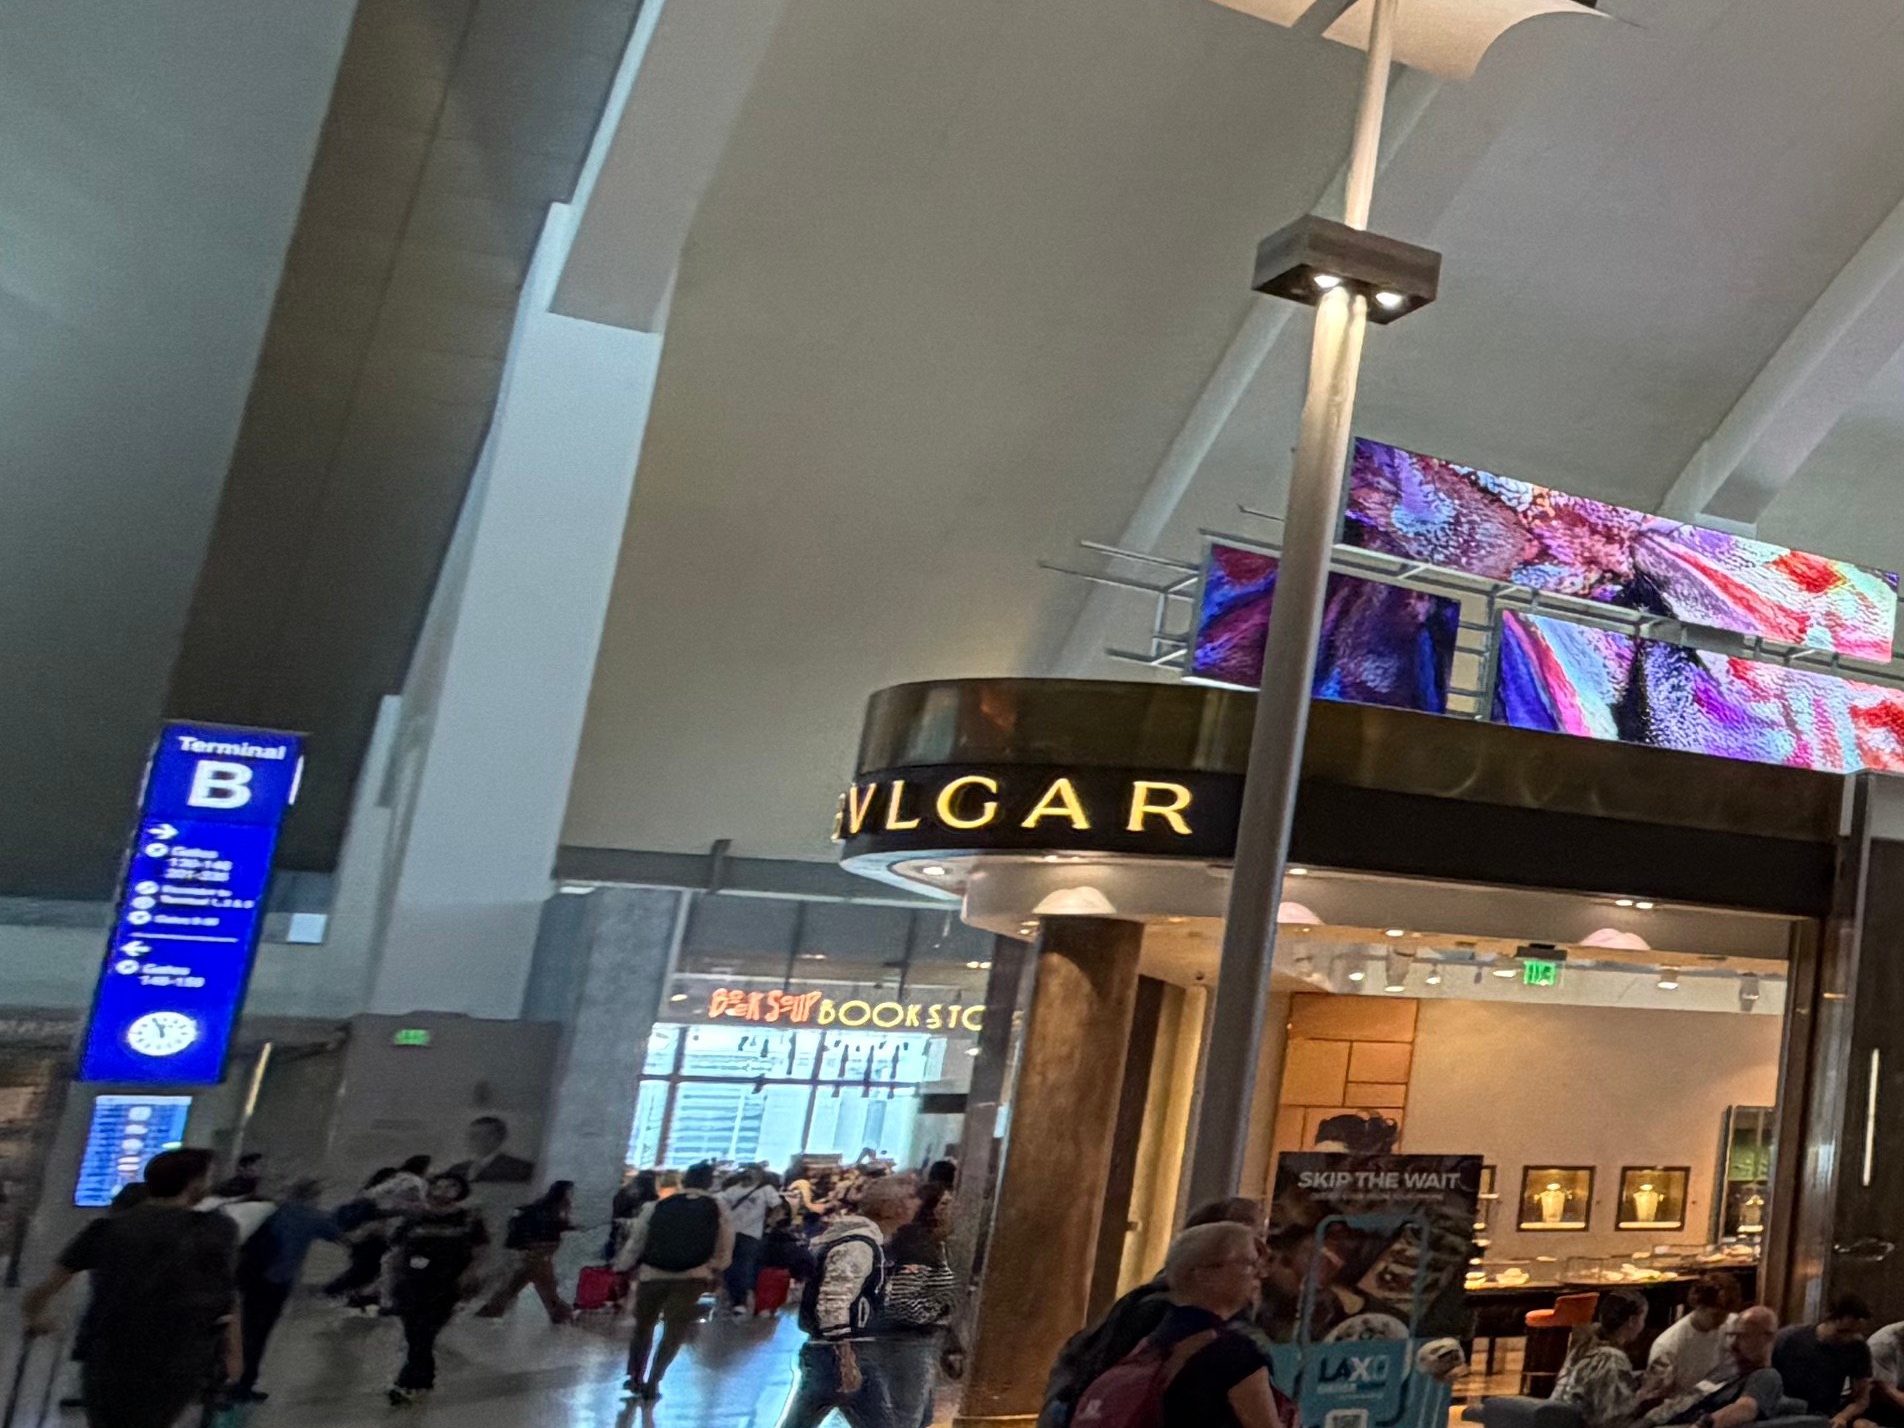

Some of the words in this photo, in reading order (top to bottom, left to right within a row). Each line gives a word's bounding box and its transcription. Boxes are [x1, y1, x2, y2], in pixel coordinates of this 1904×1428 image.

[178, 736, 287, 760] Terminal
[186, 759, 253, 809] B
[1298, 1172, 1351, 1188] SKIP
[1355, 1172, 1399, 1189] THE
[1404, 1173, 1460, 1189] WAIT
